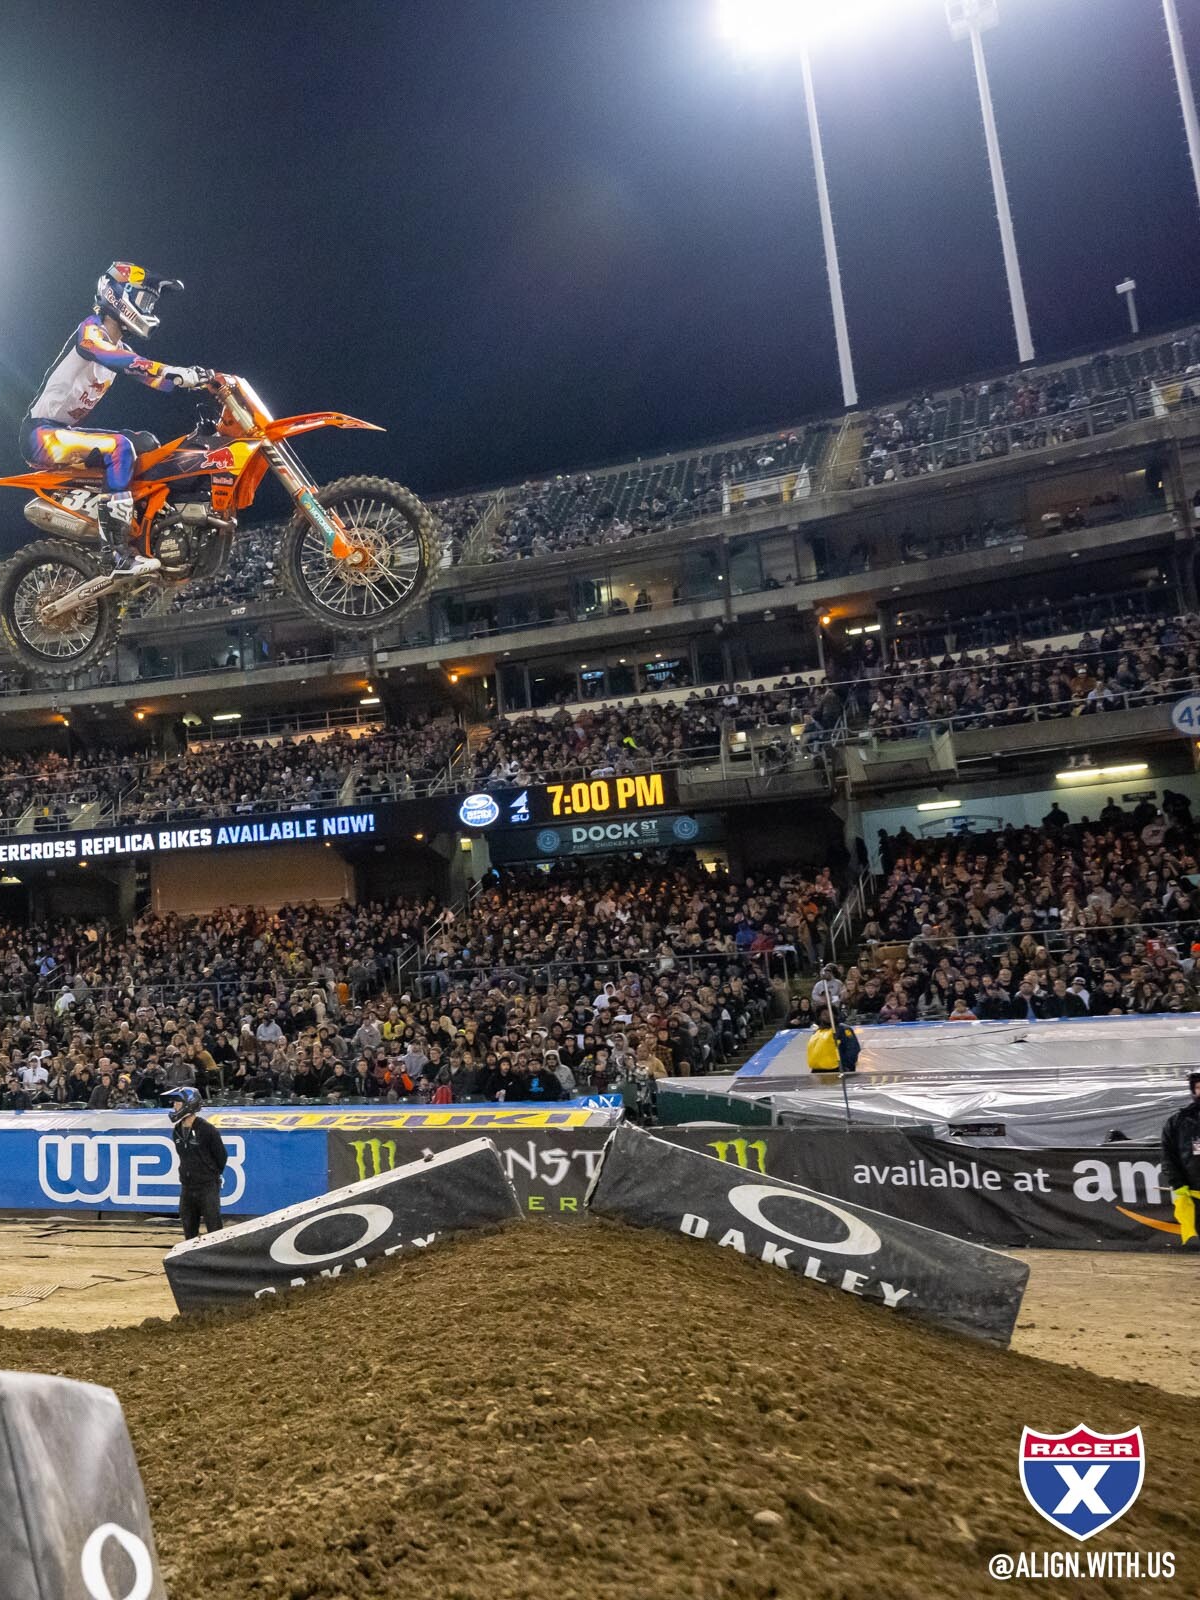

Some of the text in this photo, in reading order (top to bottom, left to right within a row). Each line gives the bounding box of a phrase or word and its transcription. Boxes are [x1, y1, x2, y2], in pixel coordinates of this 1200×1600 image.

[547, 774, 664, 815] 7:00 PM
[82, 833, 155, 856] REPLICA
[158, 828, 213, 851] BIKES
[216, 819, 317, 845] AVAILABLE
[323, 813, 375, 836] NOW!
[572, 820, 658, 843] DOCK ST
[853, 1159, 1002, 1192] available
[1014, 1167, 1051, 1193] at
[680, 1212, 915, 1308] OAKLEY
